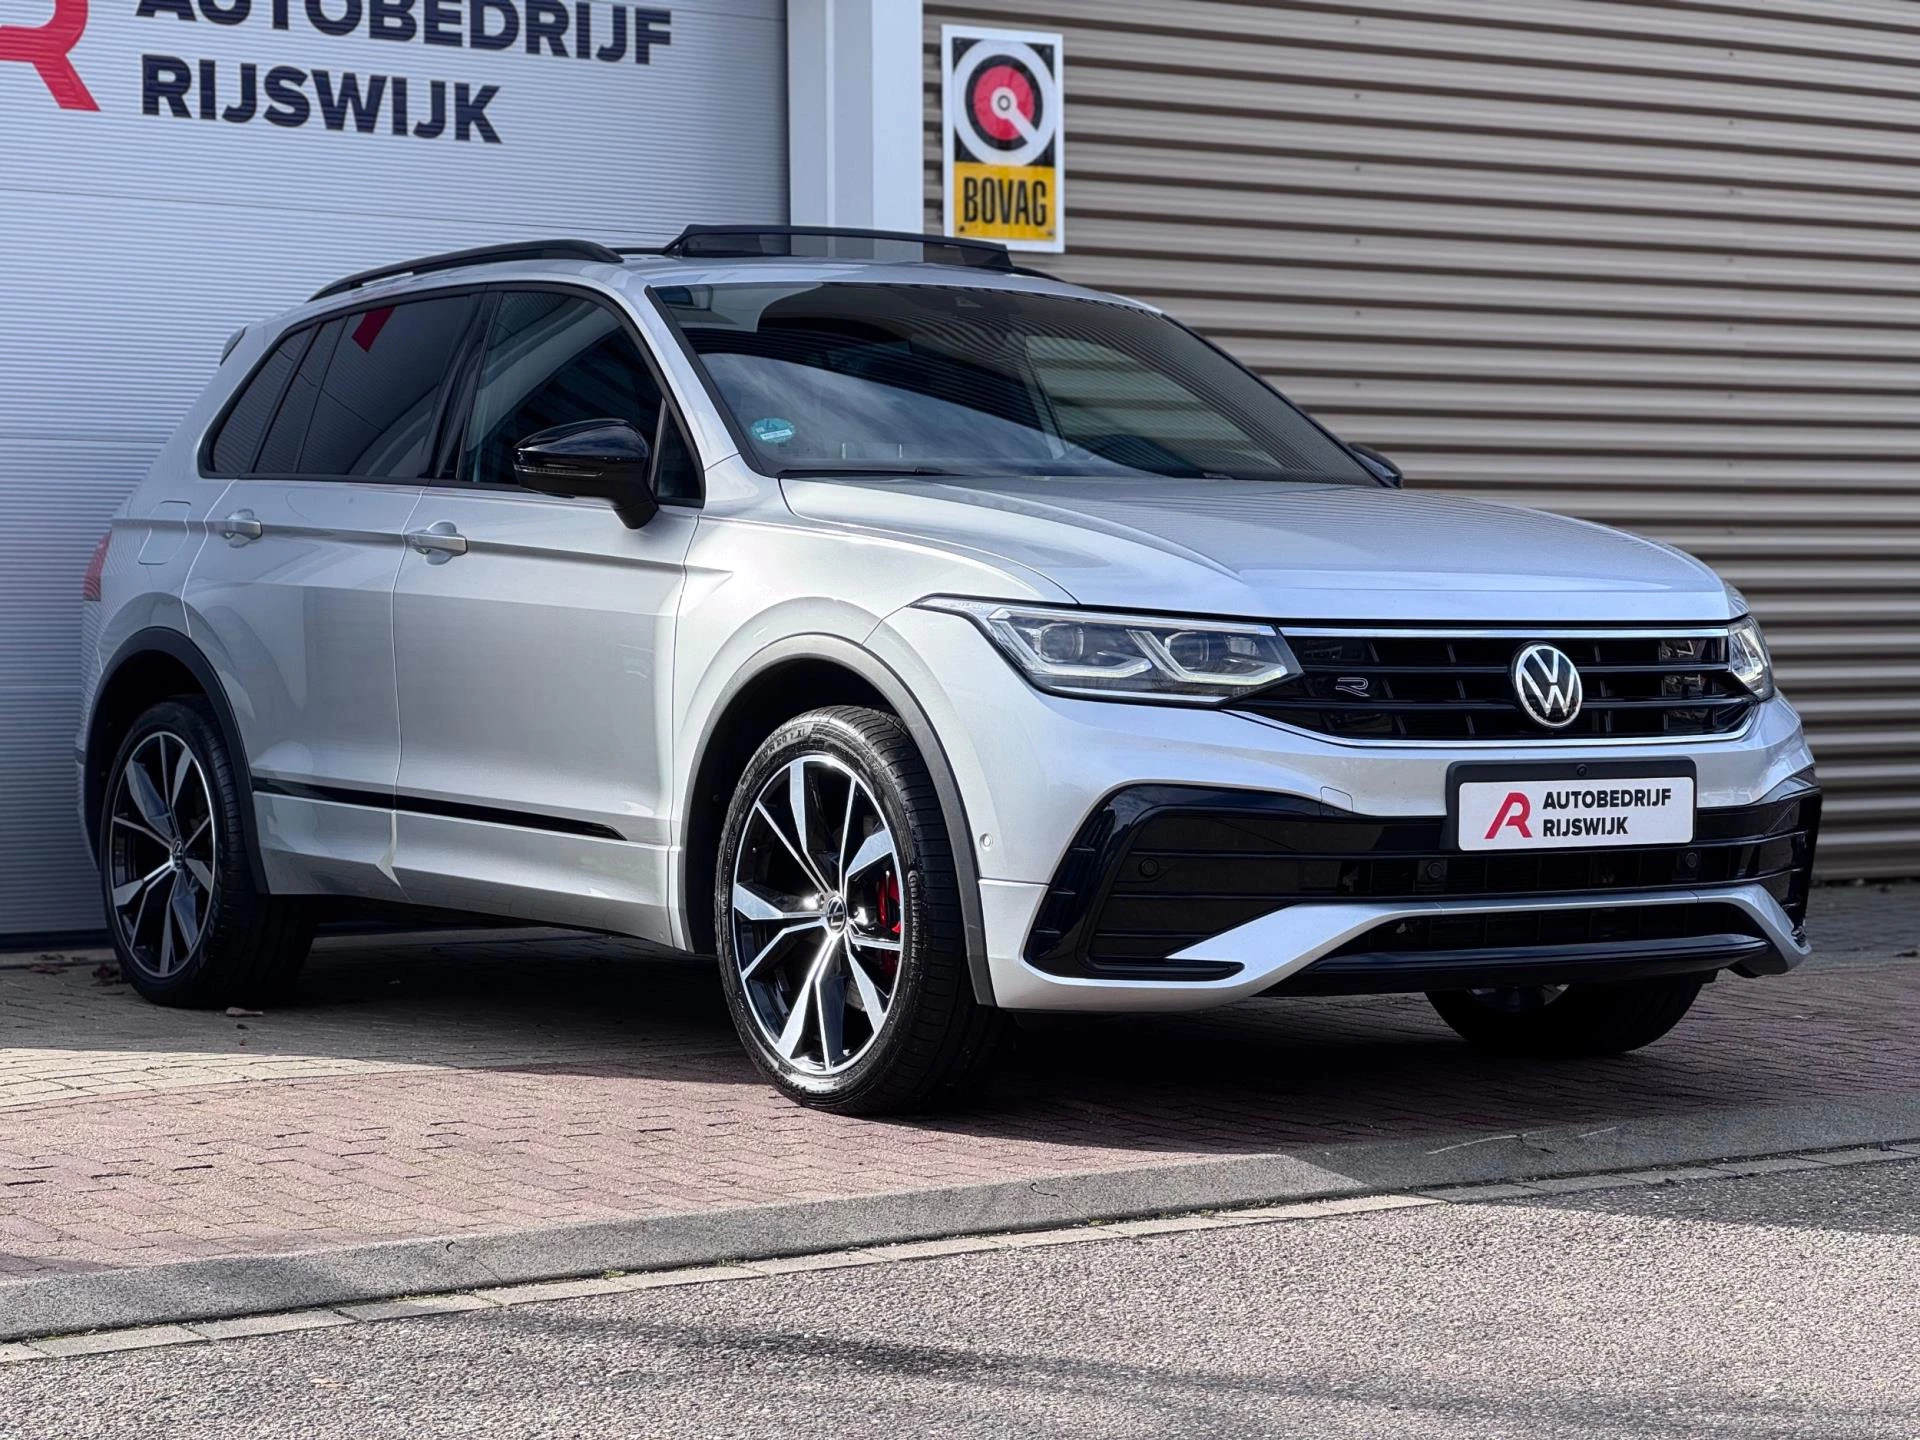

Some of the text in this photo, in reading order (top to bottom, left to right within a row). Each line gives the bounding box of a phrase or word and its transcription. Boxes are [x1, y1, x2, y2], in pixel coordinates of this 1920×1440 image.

[141, 54, 502, 144] RIJSWIJK
[963, 176, 1047, 226] BOVAG
[1335, 676, 1370, 697] R
[1542, 788, 1672, 810] AUTOBEDRIJF
[1542, 816, 1629, 837] RIJSWIJK
